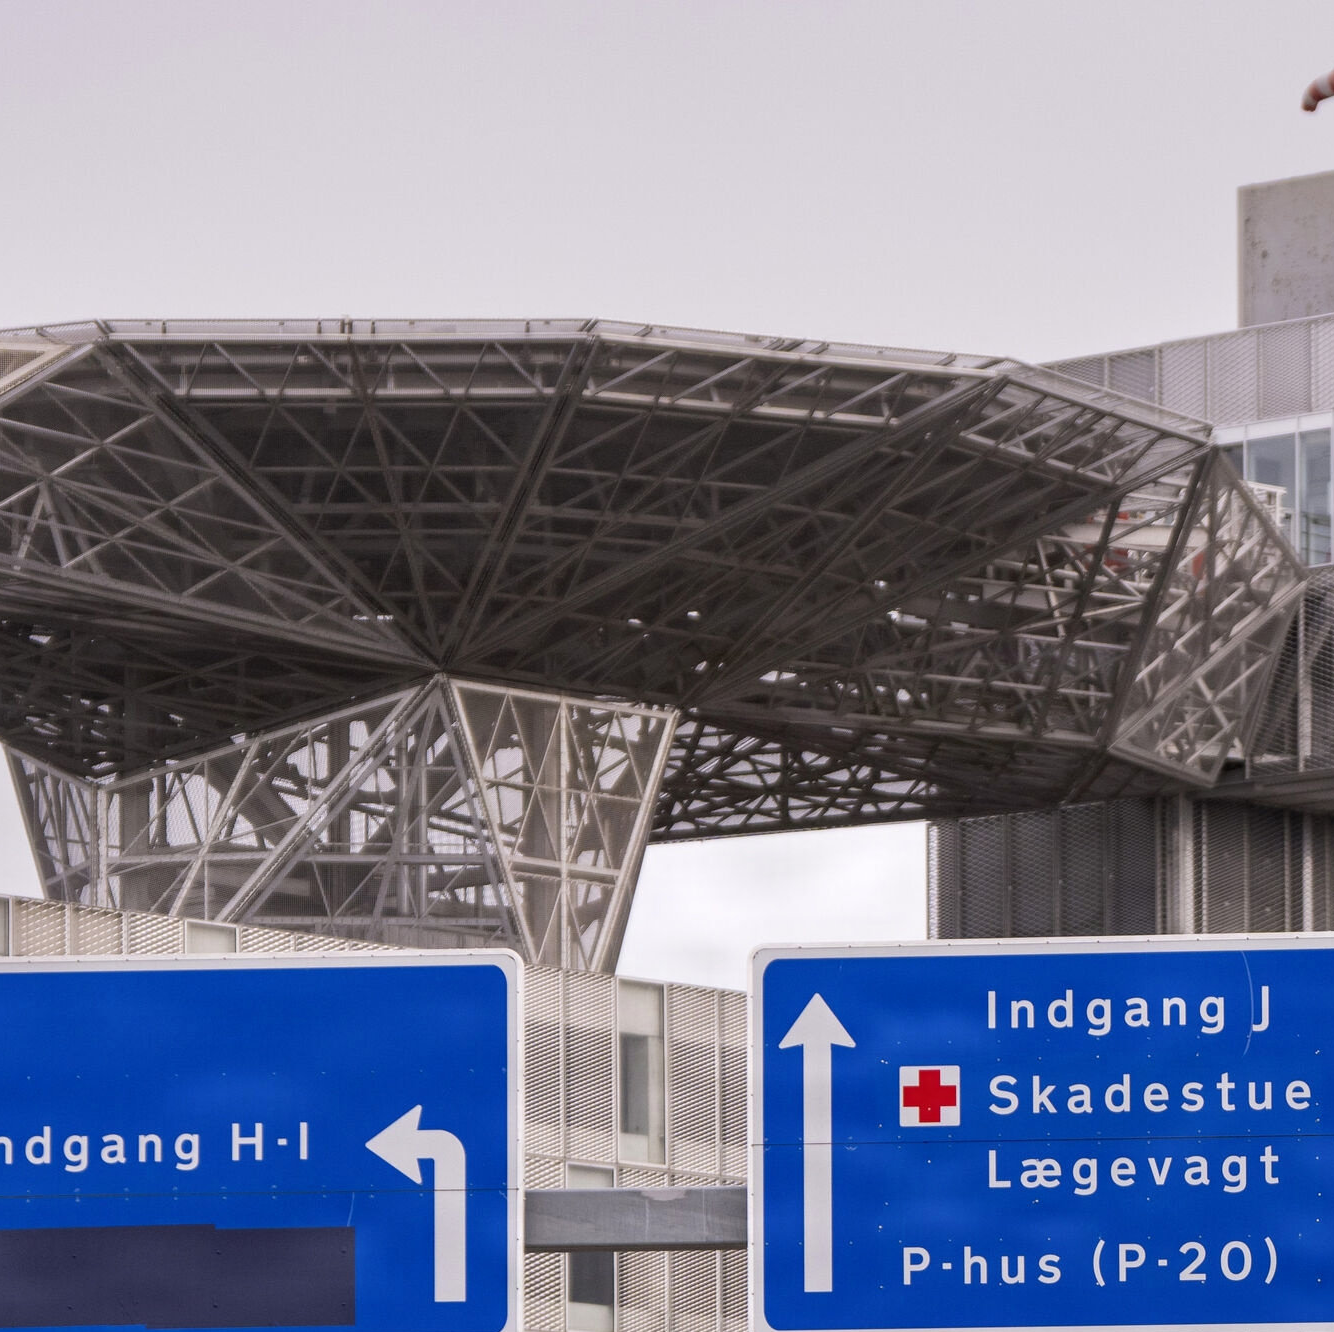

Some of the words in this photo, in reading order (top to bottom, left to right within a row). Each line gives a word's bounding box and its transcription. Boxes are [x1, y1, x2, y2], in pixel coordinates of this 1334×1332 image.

[987, 990, 1224, 1036] Indgang
[1252, 985, 1270, 1032] J
[989, 1072, 1312, 1115] Skadestue
[988, 1145, 1279, 1195] Lægevagt
[903, 1246, 1061, 1286] P-hus
[1093, 1236, 1278, 1287] (P-20)
